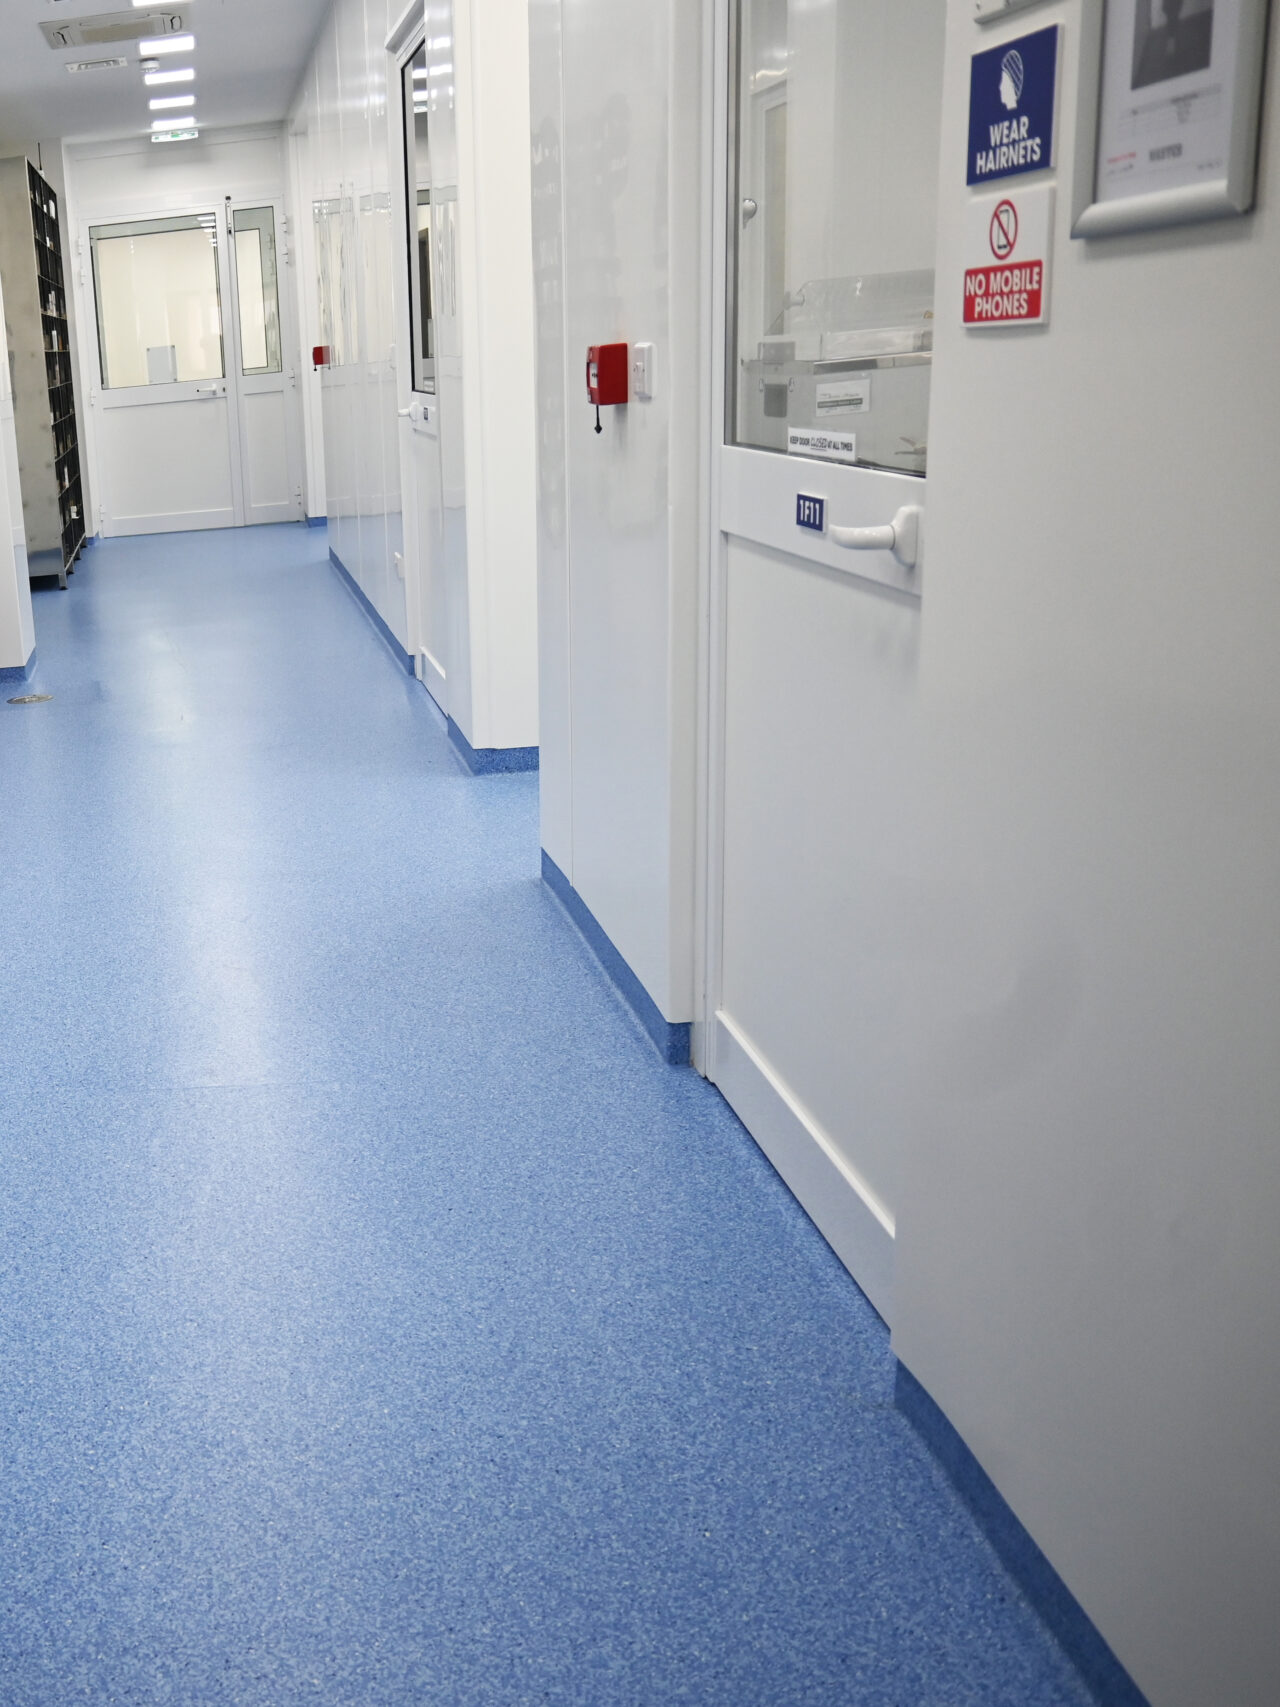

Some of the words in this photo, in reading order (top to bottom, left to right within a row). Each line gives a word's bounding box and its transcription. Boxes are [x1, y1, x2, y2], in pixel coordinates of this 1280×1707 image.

[989, 115, 1029, 148] WEAR
[976, 136, 1041, 175] HAIRNETS
[966, 273, 986, 297] NO
[989, 266, 1040, 294] MOBILE
[975, 292, 1028, 319] PHONES
[789, 435, 799, 445] KEEP
[799, 436, 810, 447] DOOR
[840, 441, 853, 452] TIMES
[800, 499, 820, 526] 1F11
